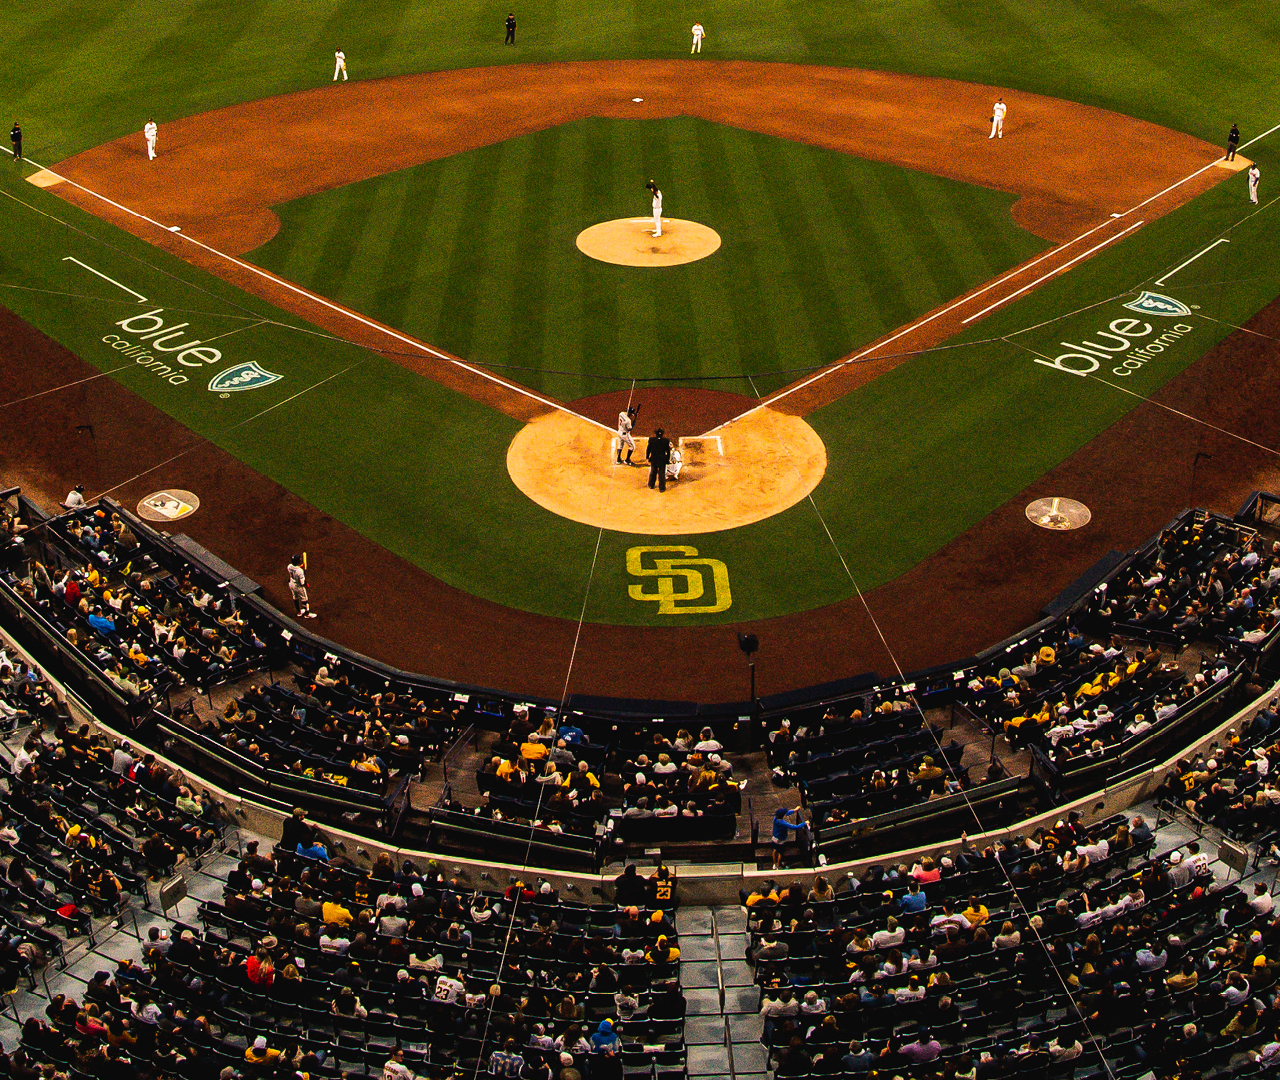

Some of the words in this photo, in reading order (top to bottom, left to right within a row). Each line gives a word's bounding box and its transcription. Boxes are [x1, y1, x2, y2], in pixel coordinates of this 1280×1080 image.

[102, 330, 191, 386] california
[115, 308, 222, 370] blue
[1033, 316, 1153, 377] blue
[1112, 322, 1194, 378] california
[626, 546, 732, 614] SD
[656, 888, 671, 900] 23
[435, 986, 450, 1000] 23
